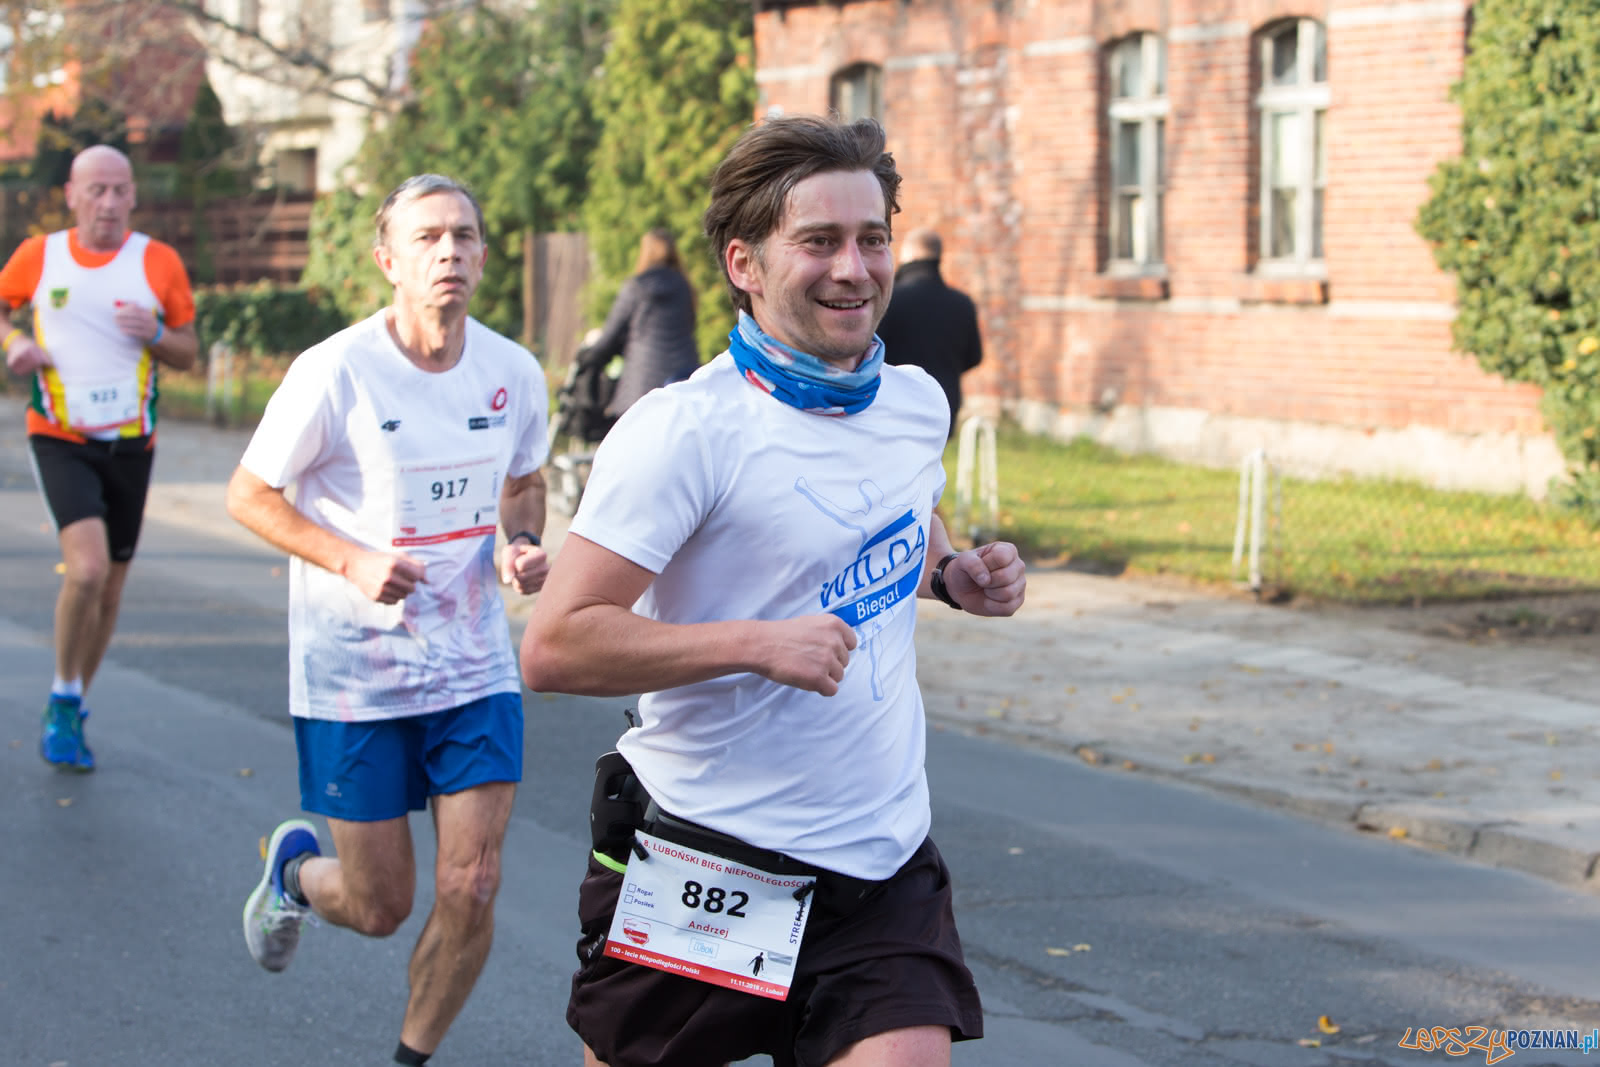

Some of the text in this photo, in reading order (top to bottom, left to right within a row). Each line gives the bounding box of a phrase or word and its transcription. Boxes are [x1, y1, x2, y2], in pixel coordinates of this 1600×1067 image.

[431, 477, 469, 501] 917
[820, 524, 925, 609] WILDA
[856, 582, 900, 621] Biega!
[643, 839, 652, 850] 8.
[652, 842, 700, 866] LUBOŃSKI
[701, 859, 722, 873] BIEG
[637, 887, 654, 897] Rogal
[681, 880, 750, 918] 882
[687, 920, 730, 938] Andrzej
[610, 945, 621, 955] 100
[624, 949, 639, 960] lecie
[682, 965, 700, 976] Polski
